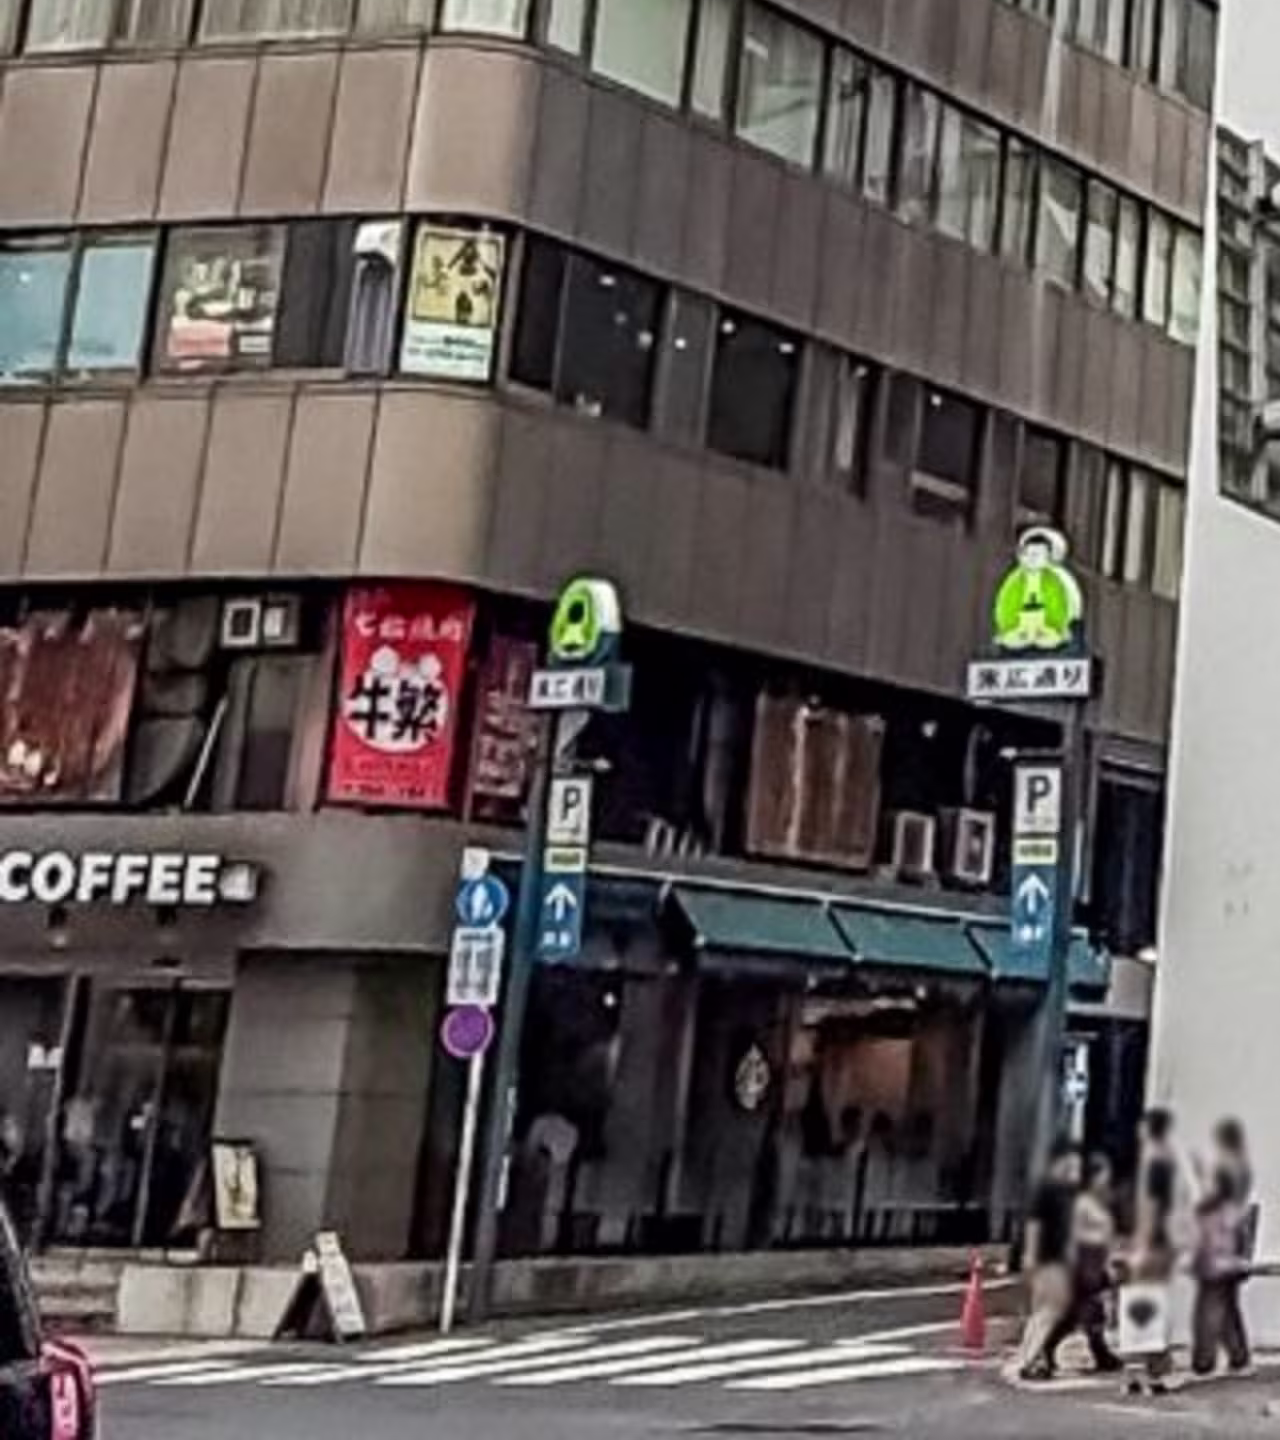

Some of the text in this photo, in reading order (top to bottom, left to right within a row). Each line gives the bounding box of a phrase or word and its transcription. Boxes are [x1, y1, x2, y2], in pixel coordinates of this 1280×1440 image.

[350, 675, 441, 742] 牛繁
[562, 786, 581, 820] P
[1027, 775, 1052, 813] P
[0, 851, 221, 904] COFFEE
